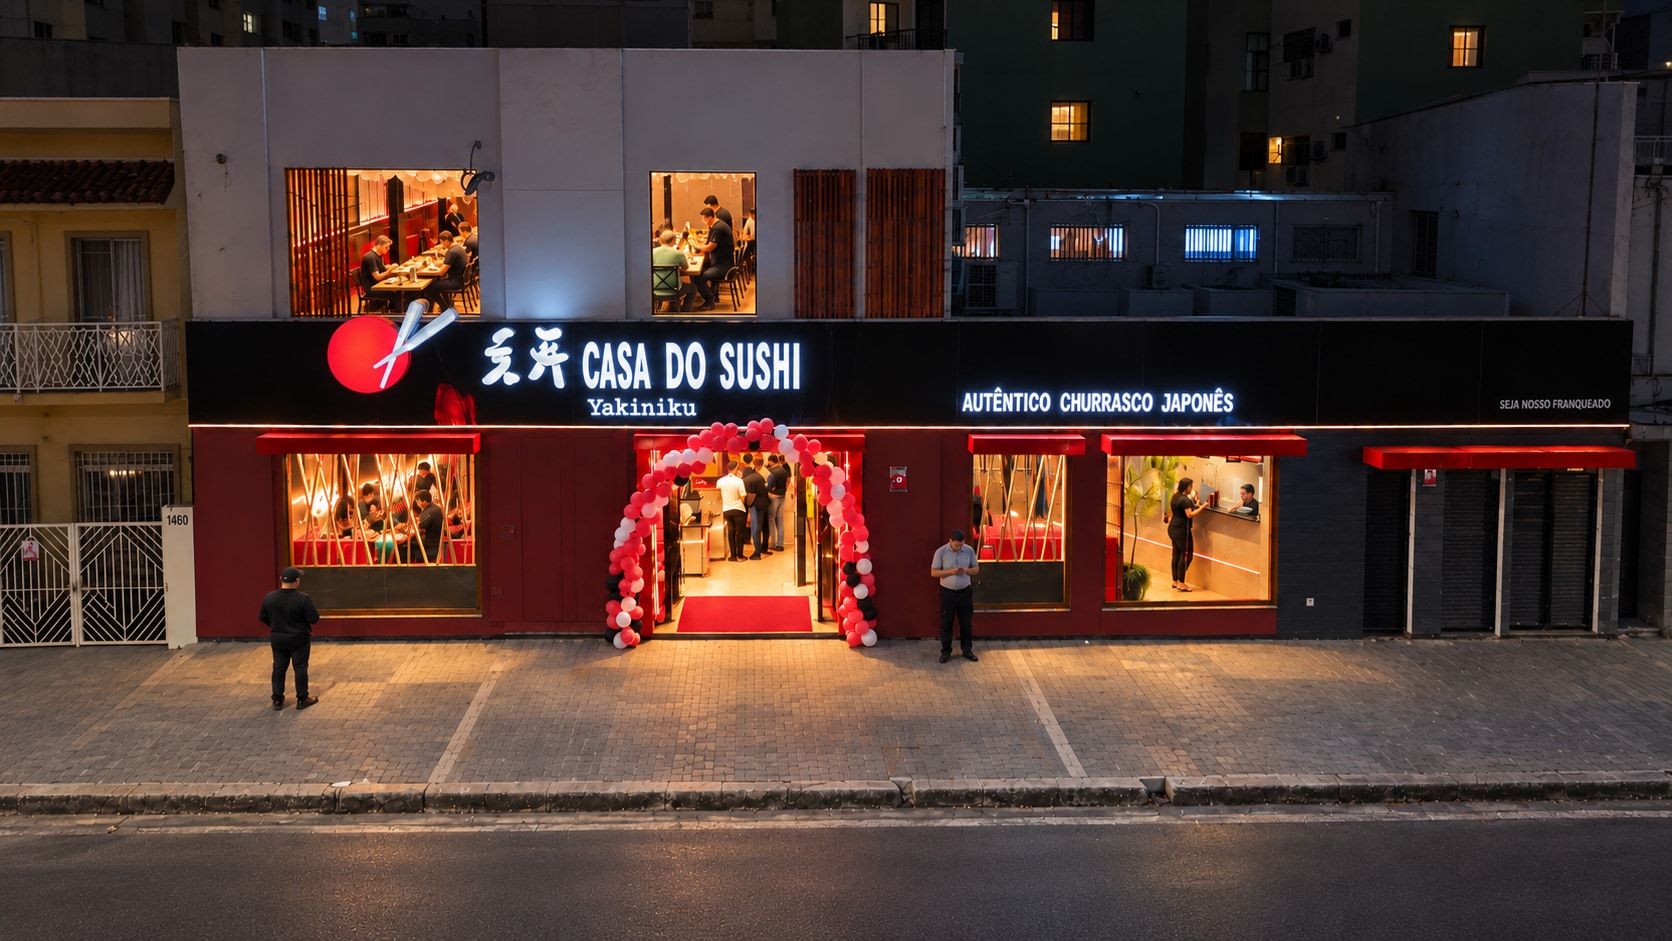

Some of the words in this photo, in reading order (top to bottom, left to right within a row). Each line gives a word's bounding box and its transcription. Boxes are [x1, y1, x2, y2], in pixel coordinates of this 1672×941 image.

[582, 341, 651, 390] CASA
[666, 341, 706, 390] DO
[720, 341, 800, 390] SUSHI
[587, 398, 697, 417] Yakiniku
[962, 387, 1051, 413] AUTÊNTICO
[1060, 392, 1153, 413] CHURRASCO
[1161, 387, 1234, 413] JAPONÊS
[1500, 399, 1519, 410] SEJA
[1521, 399, 1551, 409] NOSSO
[1552, 399, 1611, 410] FRANQUEADO
[166, 514, 189, 526] 1460
